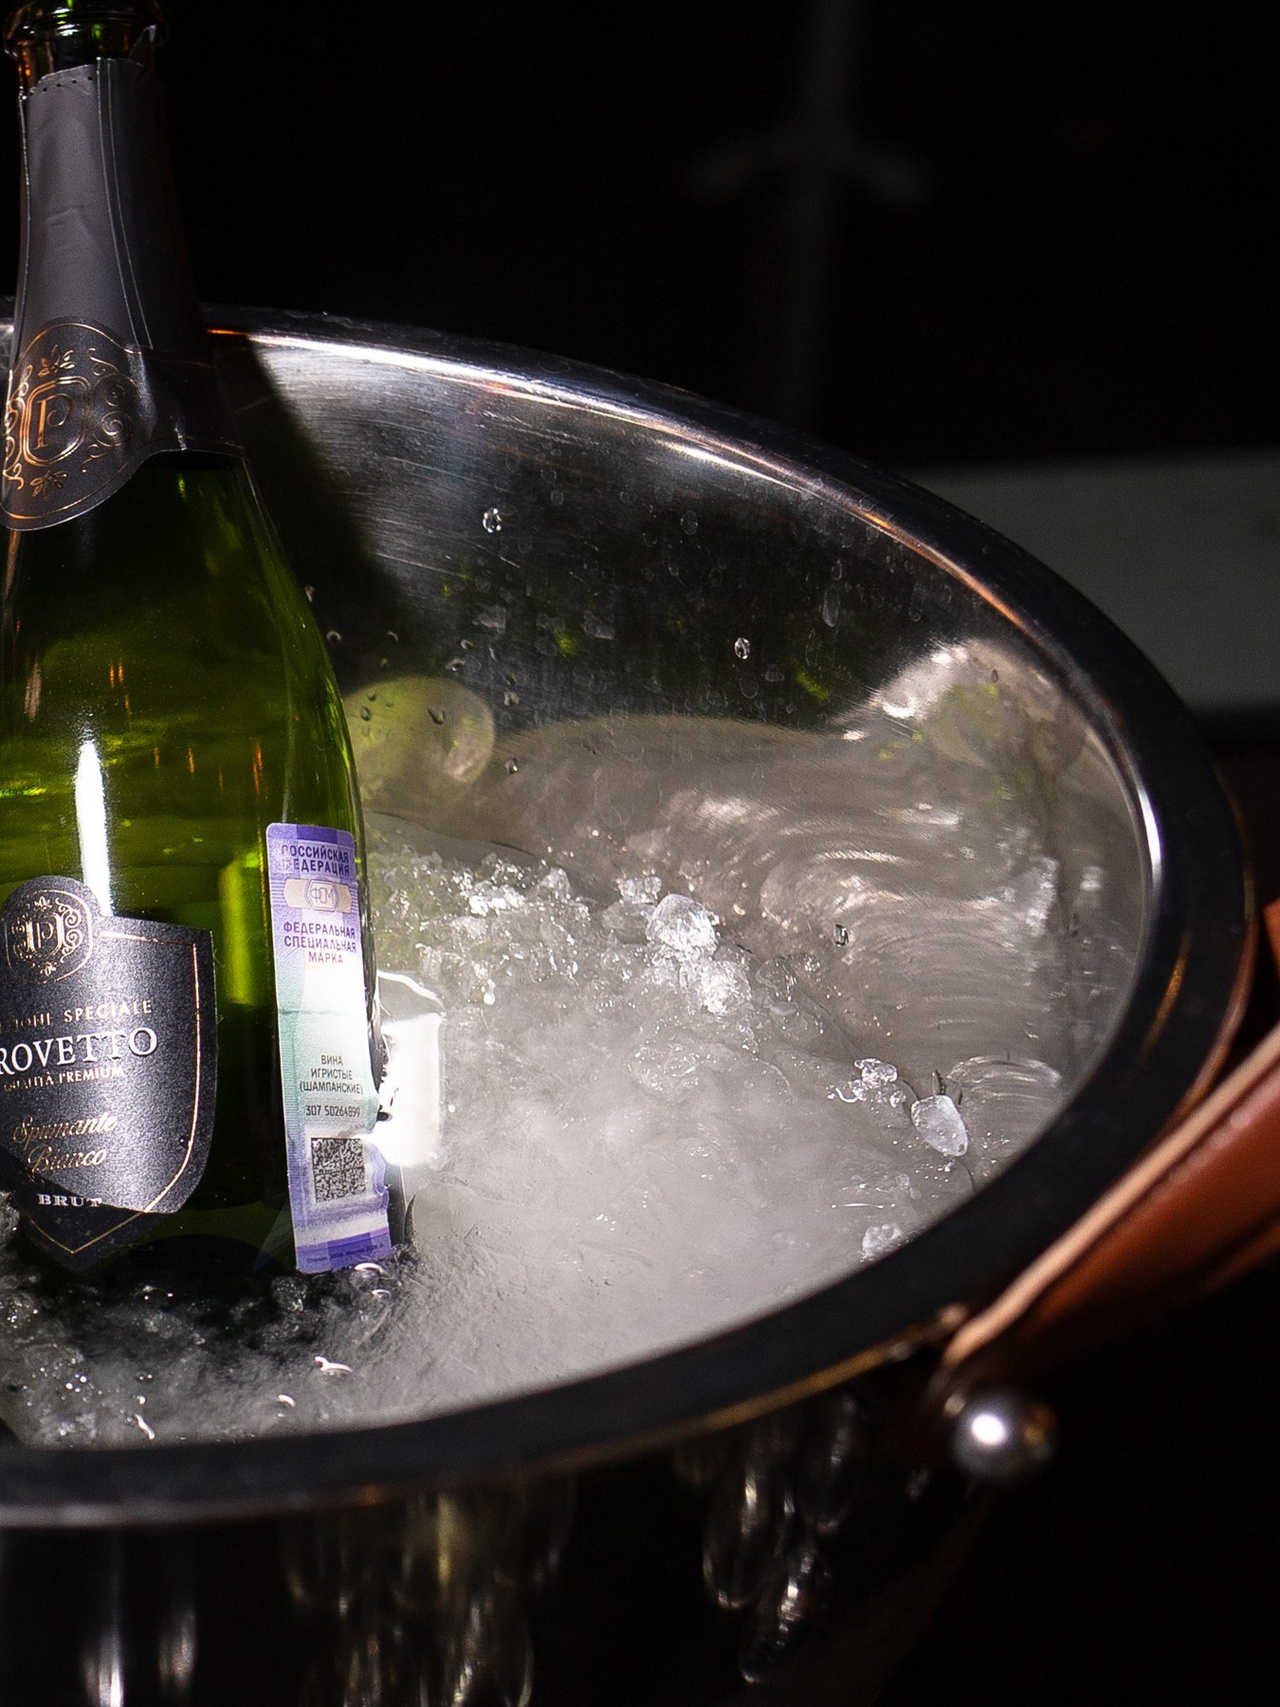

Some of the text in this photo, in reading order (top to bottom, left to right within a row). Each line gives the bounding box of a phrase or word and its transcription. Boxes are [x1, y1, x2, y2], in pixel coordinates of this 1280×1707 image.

[281, 844, 349, 863] РОССИЙСКАЯ
[283, 921, 356, 939] ФЕДЕРАЛЬНАЯ
[284, 935, 357, 953] СПЕЦИАЛЬНАЯ
[308, 951, 343, 964] МАРКА
[64, 1000, 152, 1023] SPECIALE
[321, 1055, 343, 1065] ВИНА
[59, 1066, 126, 1084] PREMIUM
[311, 1068, 353, 1080] ИГРИСТЫЕ
[300, 1081, 363, 1095] (ШАМПАНСКИЕ)
[305, 1105, 321, 1116] 307
[13, 1112, 118, 1150] Spumante
[27, 1145, 107, 1173] Bianco
[37, 1193, 102, 1208] BRUT
